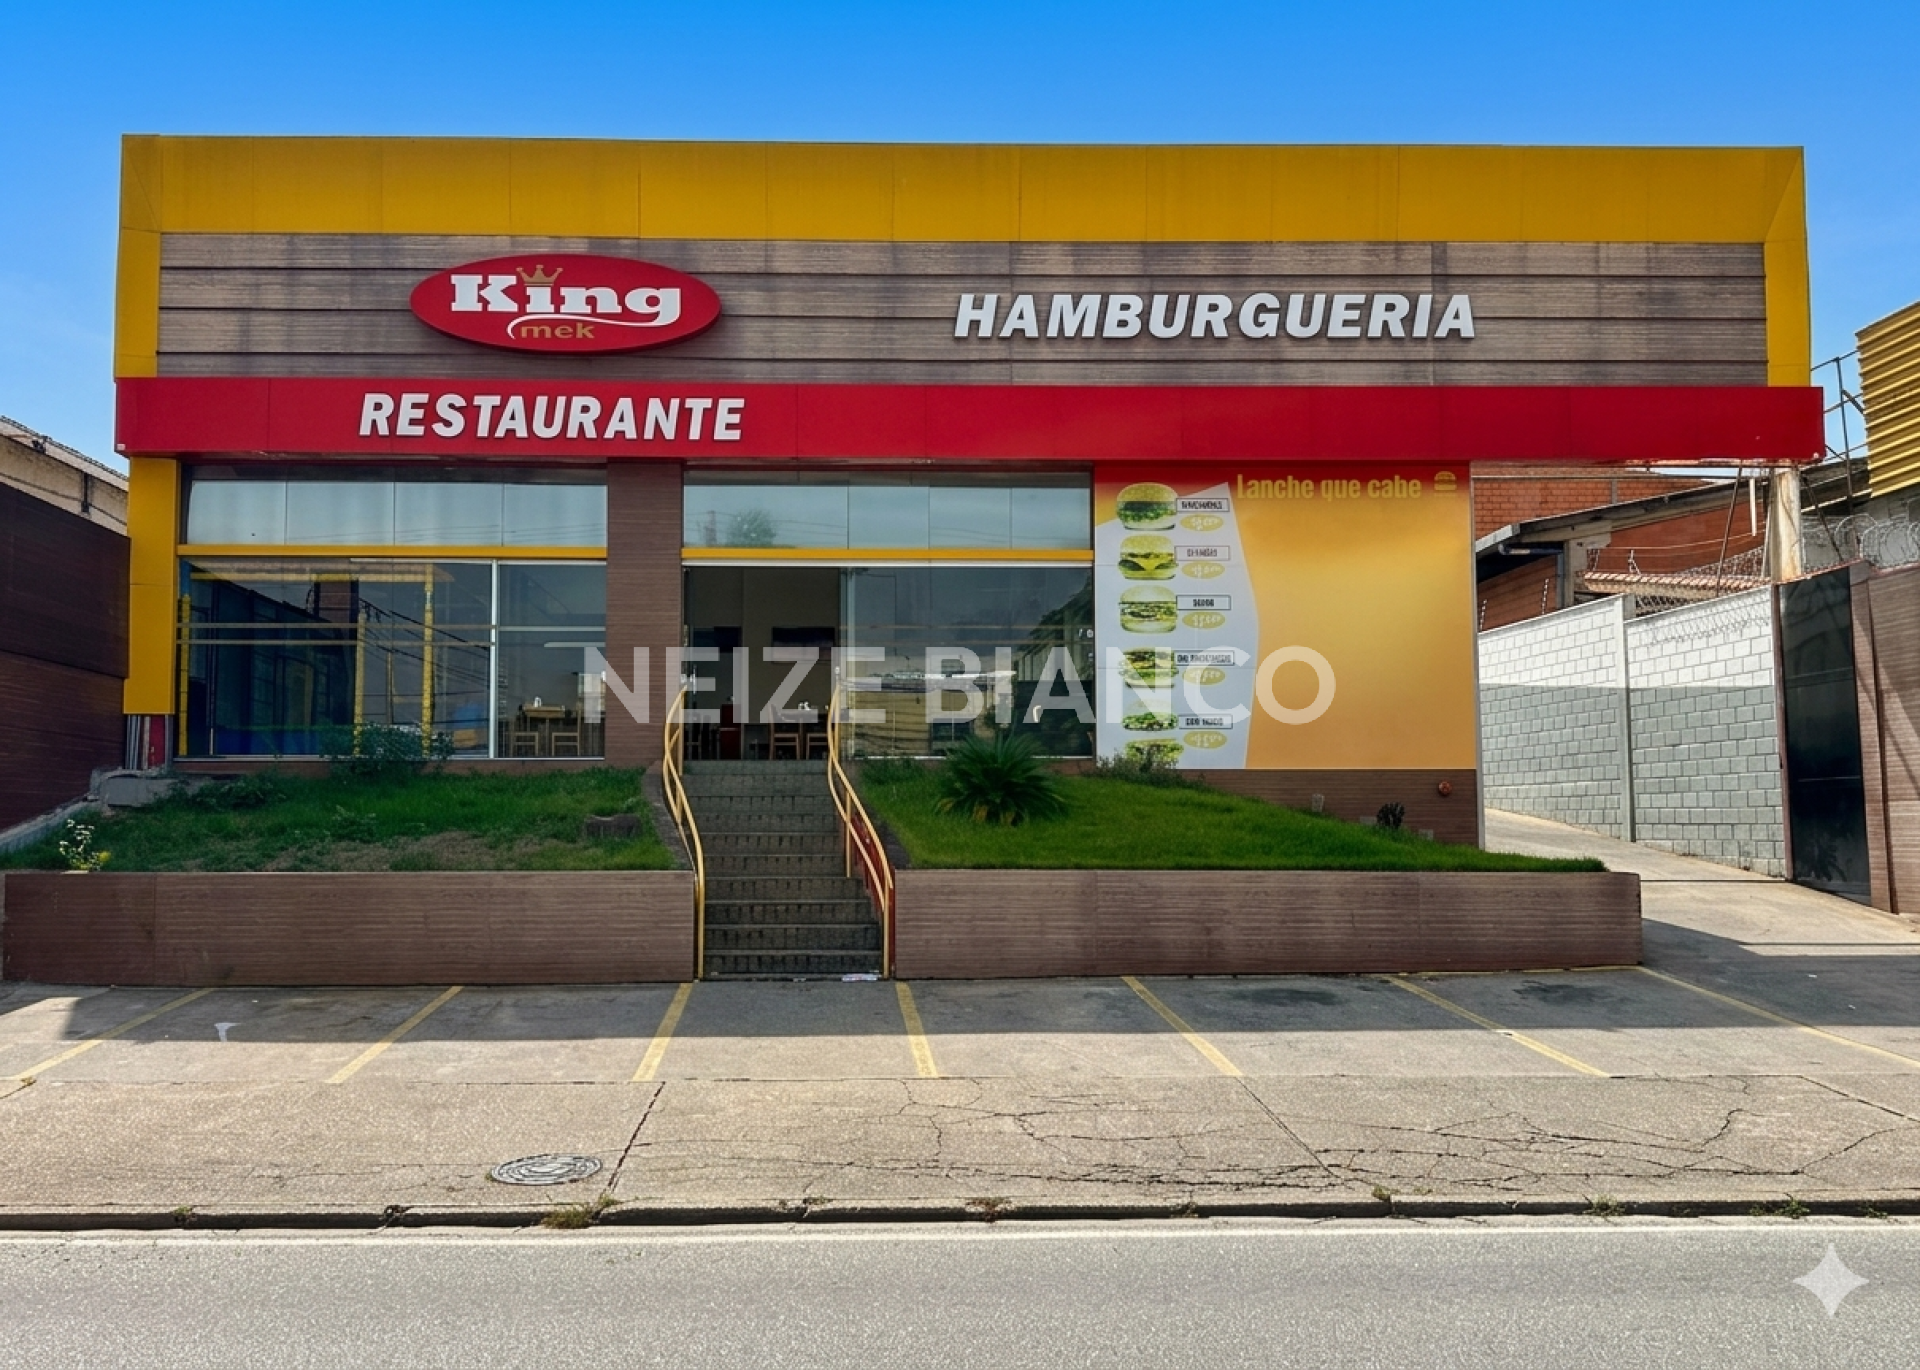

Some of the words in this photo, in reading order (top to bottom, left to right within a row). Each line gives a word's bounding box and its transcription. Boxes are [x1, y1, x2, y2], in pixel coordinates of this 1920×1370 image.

[451, 274, 682, 327] King
[953, 293, 1476, 339] HAMBURGUERIA
[520, 322, 596, 340] mek
[358, 392, 746, 441] RESTAURANTE
[1236, 473, 1315, 499] Lanche
[1320, 478, 1362, 502] que
[1367, 475, 1422, 499] cabe
